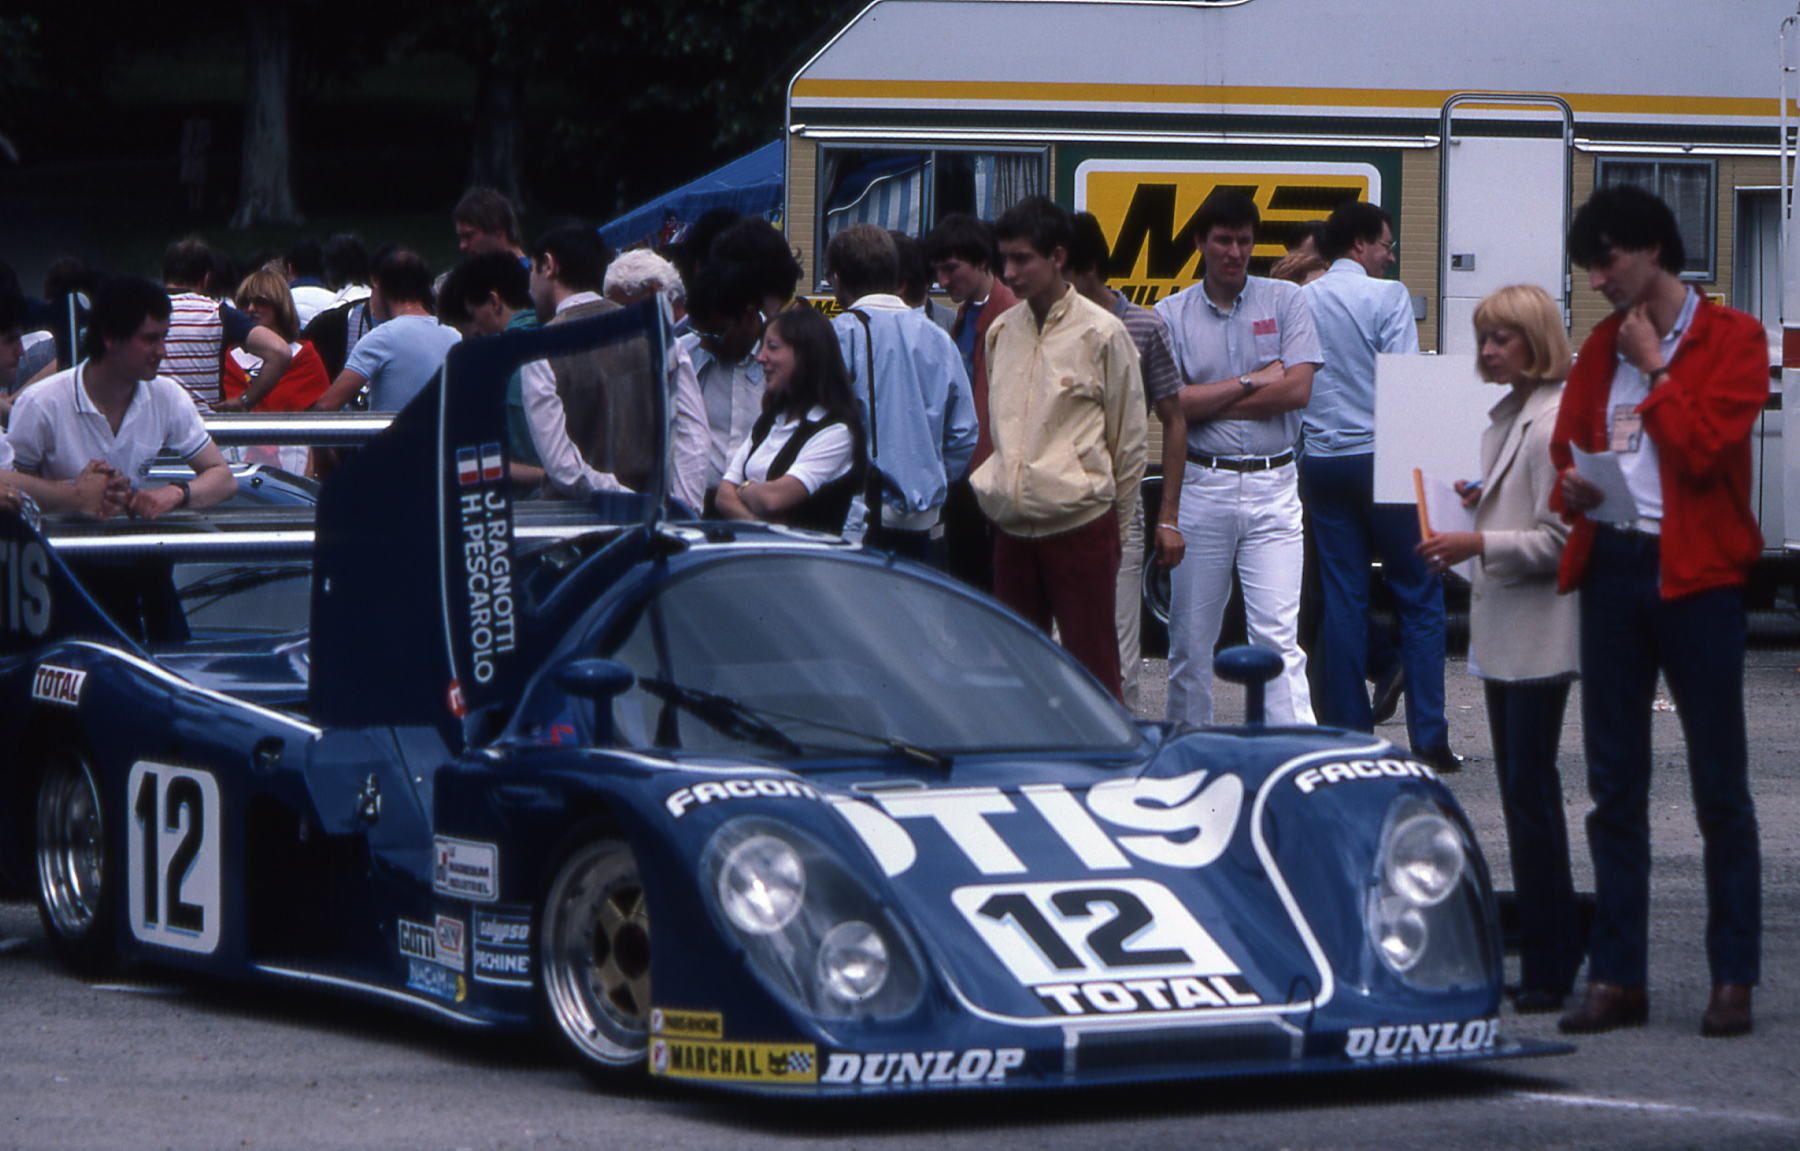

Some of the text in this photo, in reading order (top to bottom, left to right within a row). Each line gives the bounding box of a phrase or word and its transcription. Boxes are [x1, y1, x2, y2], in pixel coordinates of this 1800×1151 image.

[35, 666, 80, 699] TOTAL
[135, 772, 204, 932] 12
[976, 887, 1195, 972] 12
[1034, 976, 1262, 1014] TOTAL
[671, 1045, 763, 1074] MARCHAL
[820, 1048, 1026, 1084] DUNLOP
